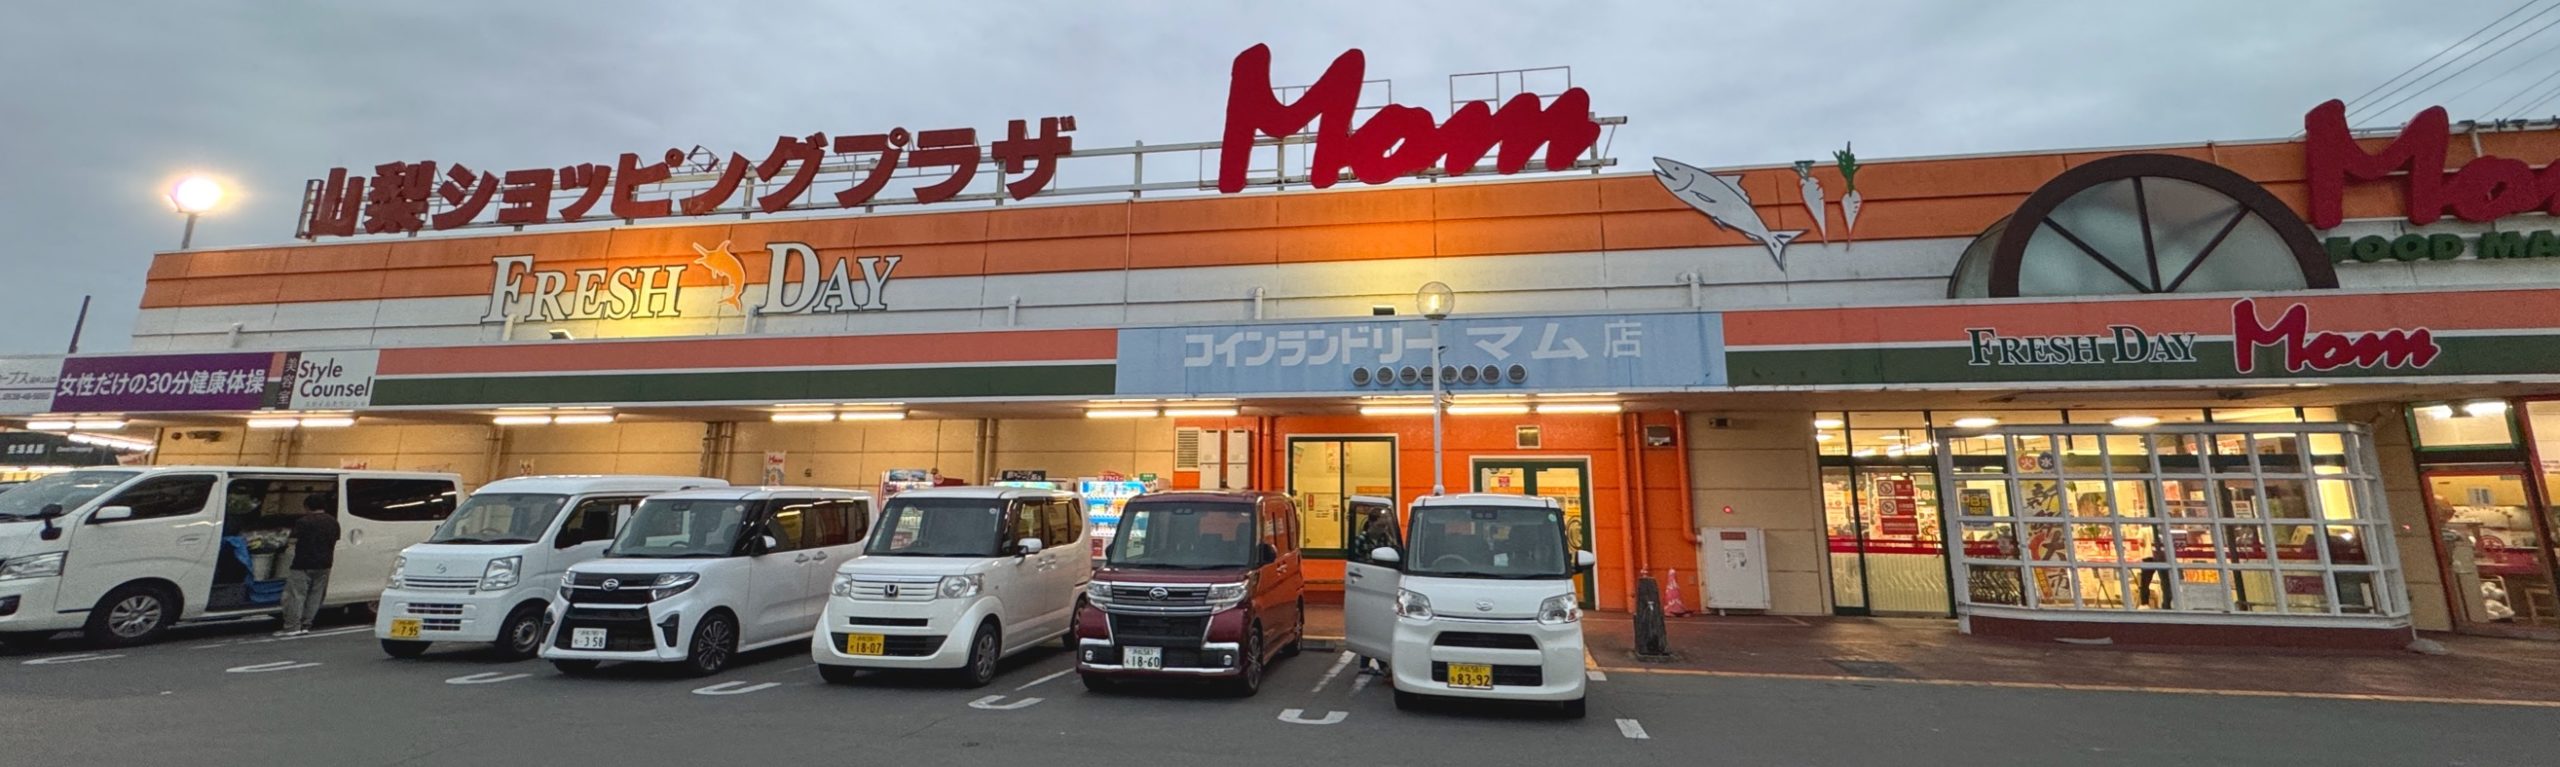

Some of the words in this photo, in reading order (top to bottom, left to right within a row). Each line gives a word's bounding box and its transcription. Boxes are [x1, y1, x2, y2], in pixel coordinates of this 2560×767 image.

[1218, 43, 1601, 193] Mom
[307, 114, 1076, 237] 山梨ショッピングプラザ
[2305, 98, 2560, 229] Mo
[2324, 233, 2465, 264] FOOD
[481, 254, 688, 324] FRESH
[759, 241, 903, 314] DAY
[1184, 323, 1436, 367] コインランドリー
[1466, 325, 1591, 361] マム
[1603, 320, 1643, 358] 店
[1964, 327, 2104, 365] FRESH
[2112, 324, 2197, 363] DAY
[2232, 297, 2442, 373] Mom
[58, 369, 266, 397] 女性だけの30分健康体操
[277, 358, 297, 405] 美容室
[299, 358, 343, 383] Style
[300, 376, 371, 398] Counsel
[856, 642, 882, 653] 18-07
[1132, 656, 1160, 668] 18-60
[1457, 673, 1490, 687] 83-92
